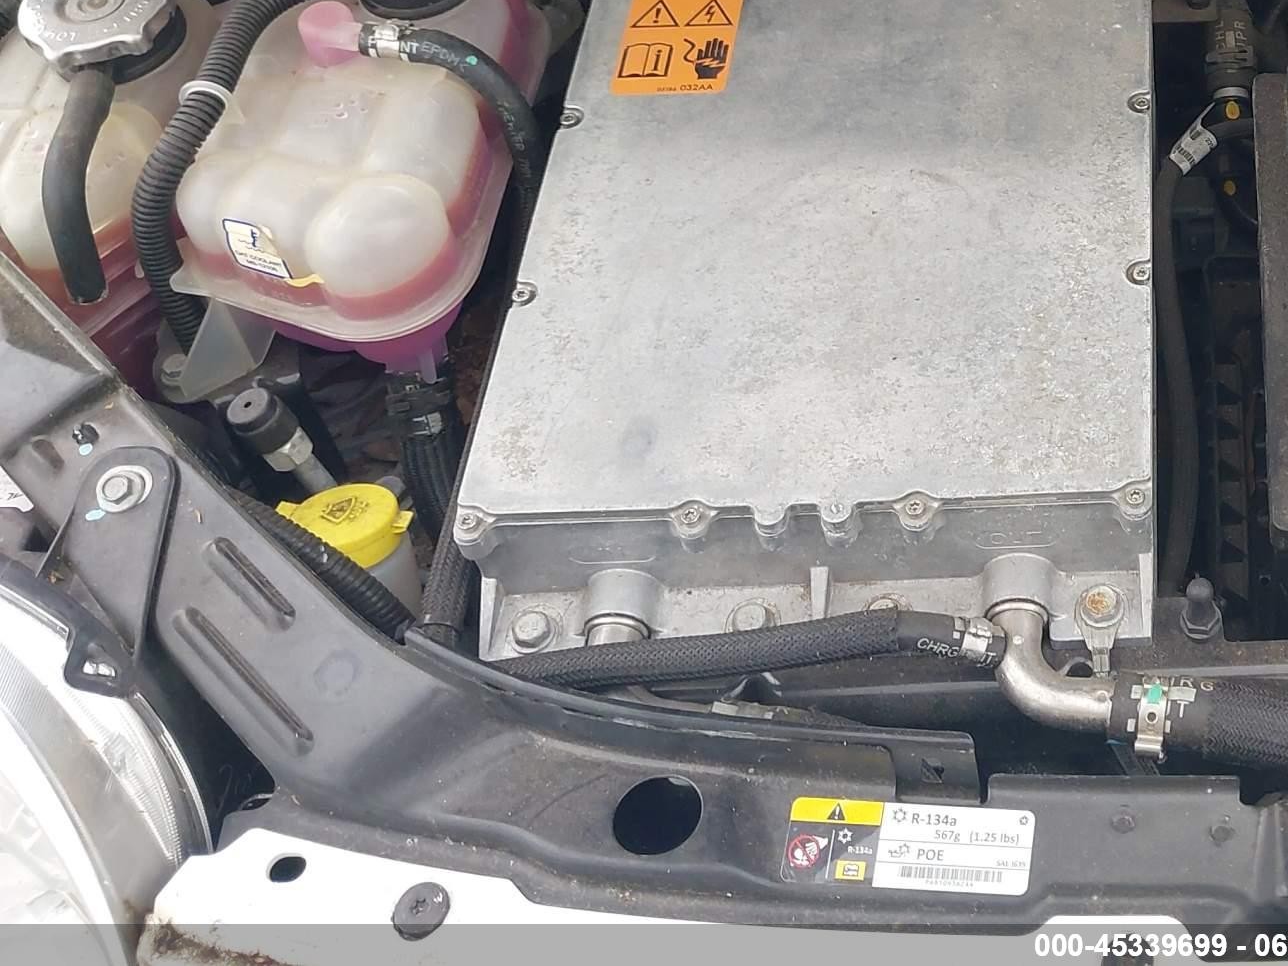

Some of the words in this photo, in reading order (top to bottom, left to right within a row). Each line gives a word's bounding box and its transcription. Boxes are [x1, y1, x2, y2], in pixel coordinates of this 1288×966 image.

[917, 638, 960, 658] CHRG
[912, 812, 958, 826] R-134a
[934, 830, 960, 842] 567g
[970, 832, 996, 843] (1.25
[1000, 833, 1020, 844] lbs)
[917, 848, 944, 861] POE
